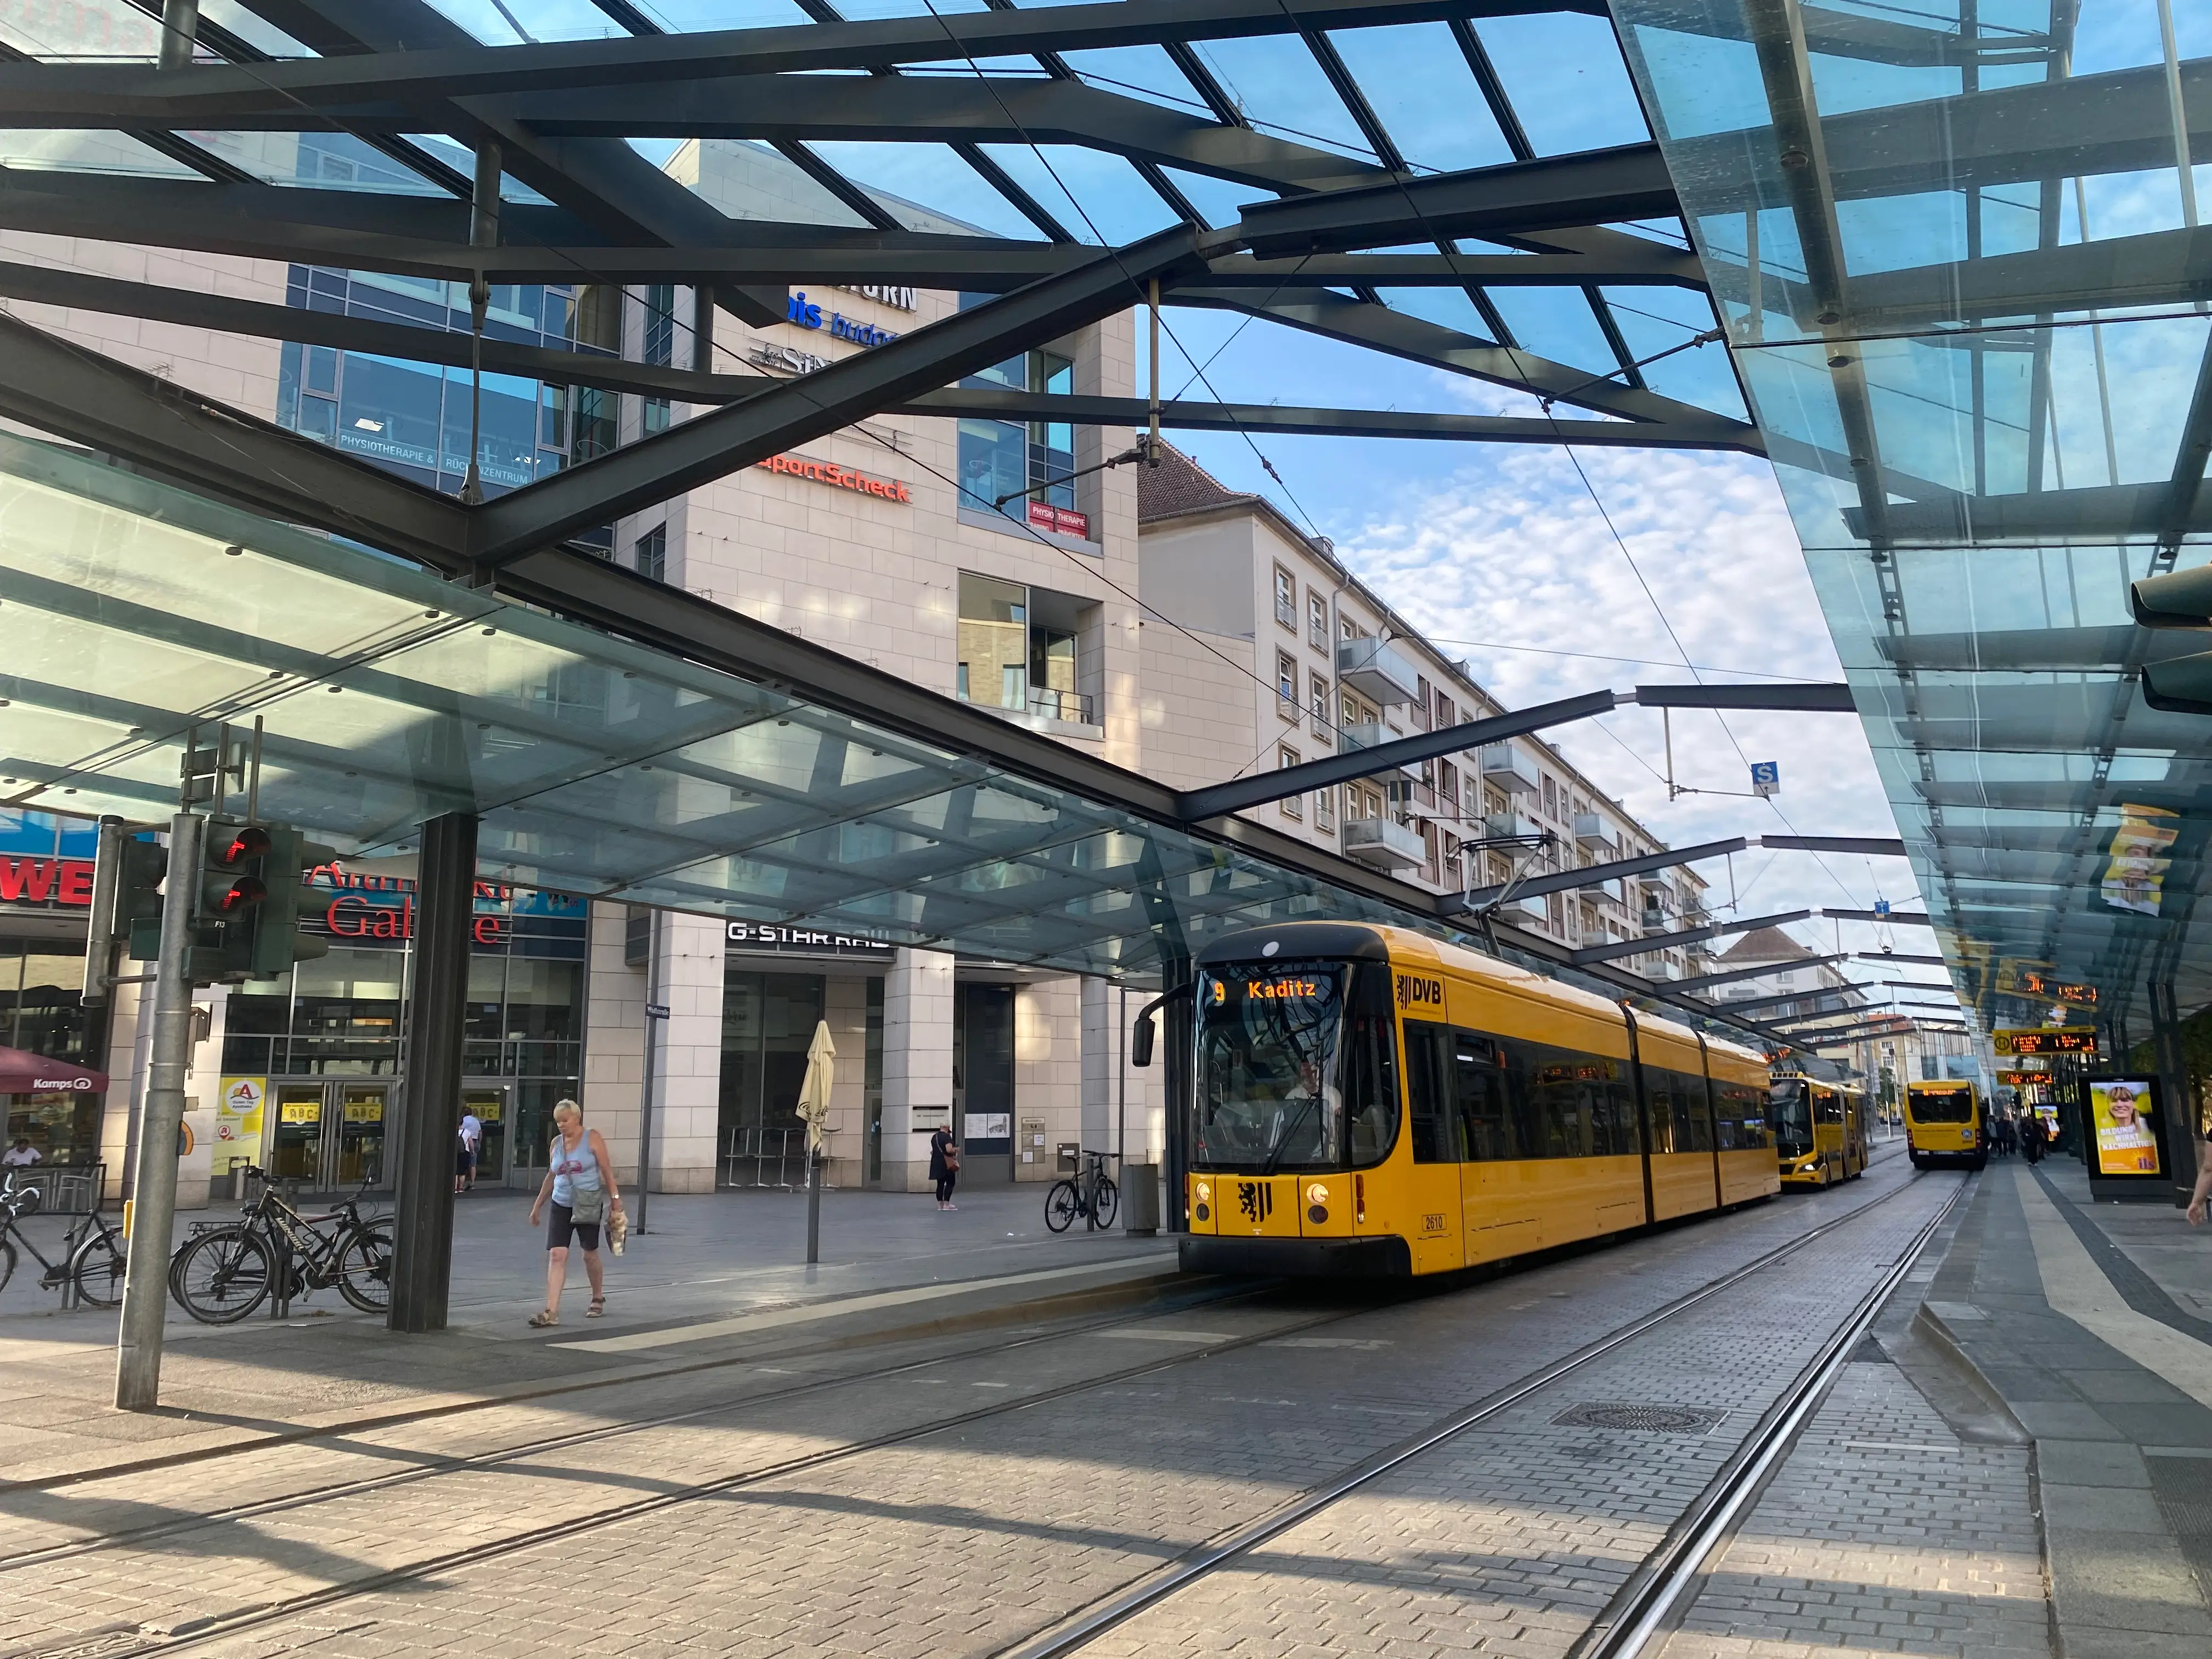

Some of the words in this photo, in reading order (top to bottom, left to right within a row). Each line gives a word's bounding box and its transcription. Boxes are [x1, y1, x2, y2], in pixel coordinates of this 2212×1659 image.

[341, 435, 424, 462] PHYSIOTHERAPIE
[426, 454, 434, 464] &
[445, 458, 528, 484] RÜCNZENTRUM
[1032, 506, 1054, 519] PHYSIO
[1057, 512, 1086, 527] THERAPIE
[1757, 766, 1773, 783] S
[1214, 983, 1226, 1001] 9
[1249, 980, 1316, 998] Kaditz
[1413, 977, 1441, 1005] DVB
[33, 1079, 73, 1090] Kamps
[1426, 1216, 1443, 1229] 2610
